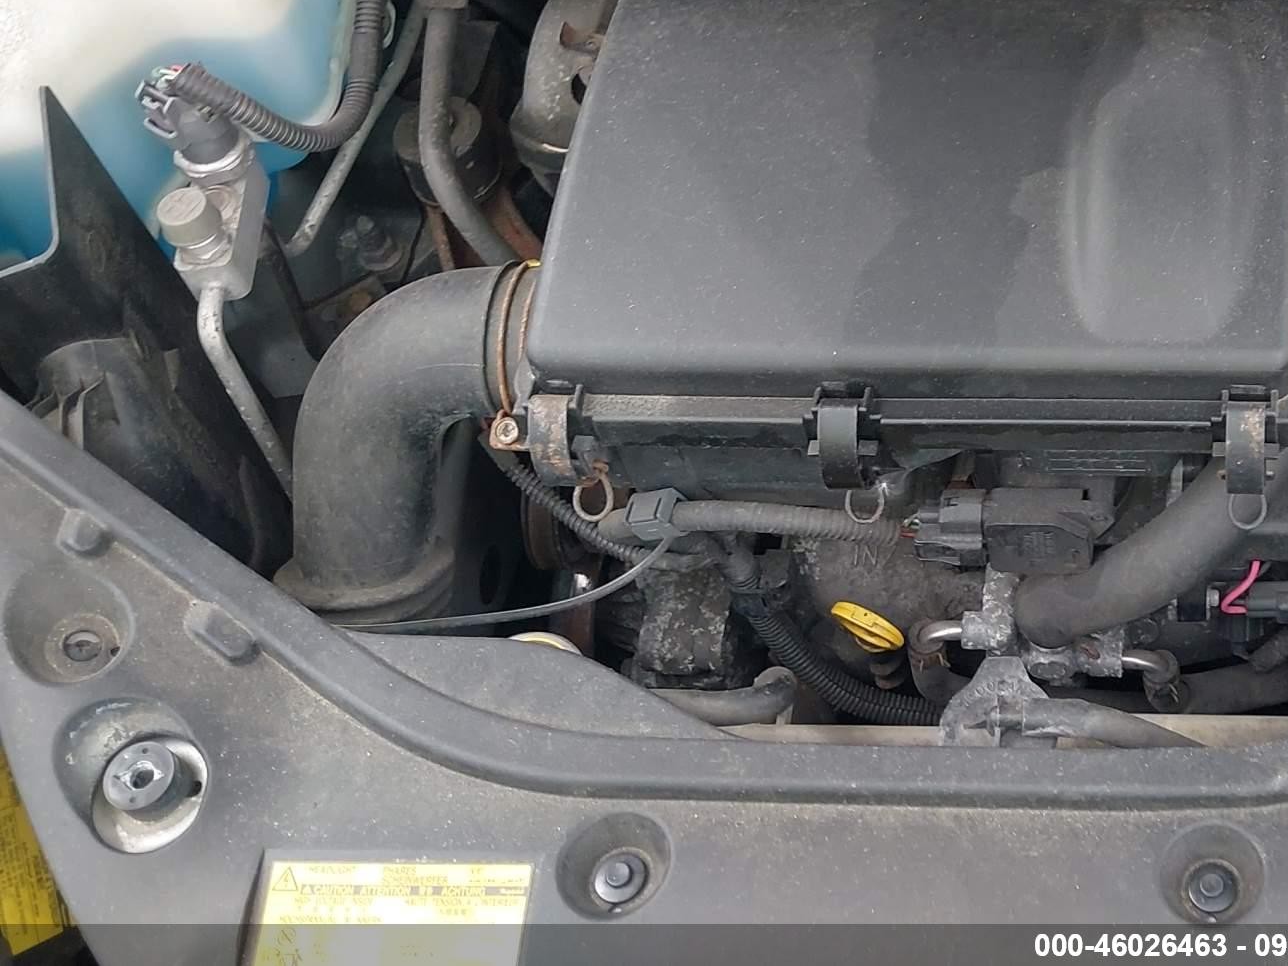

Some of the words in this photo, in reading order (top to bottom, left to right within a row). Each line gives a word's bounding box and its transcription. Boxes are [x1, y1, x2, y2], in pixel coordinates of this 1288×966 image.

[314, 884, 353, 896] CAUTION
[360, 885, 411, 897] ATTENTION
[441, 885, 486, 897] ACHTUNG
